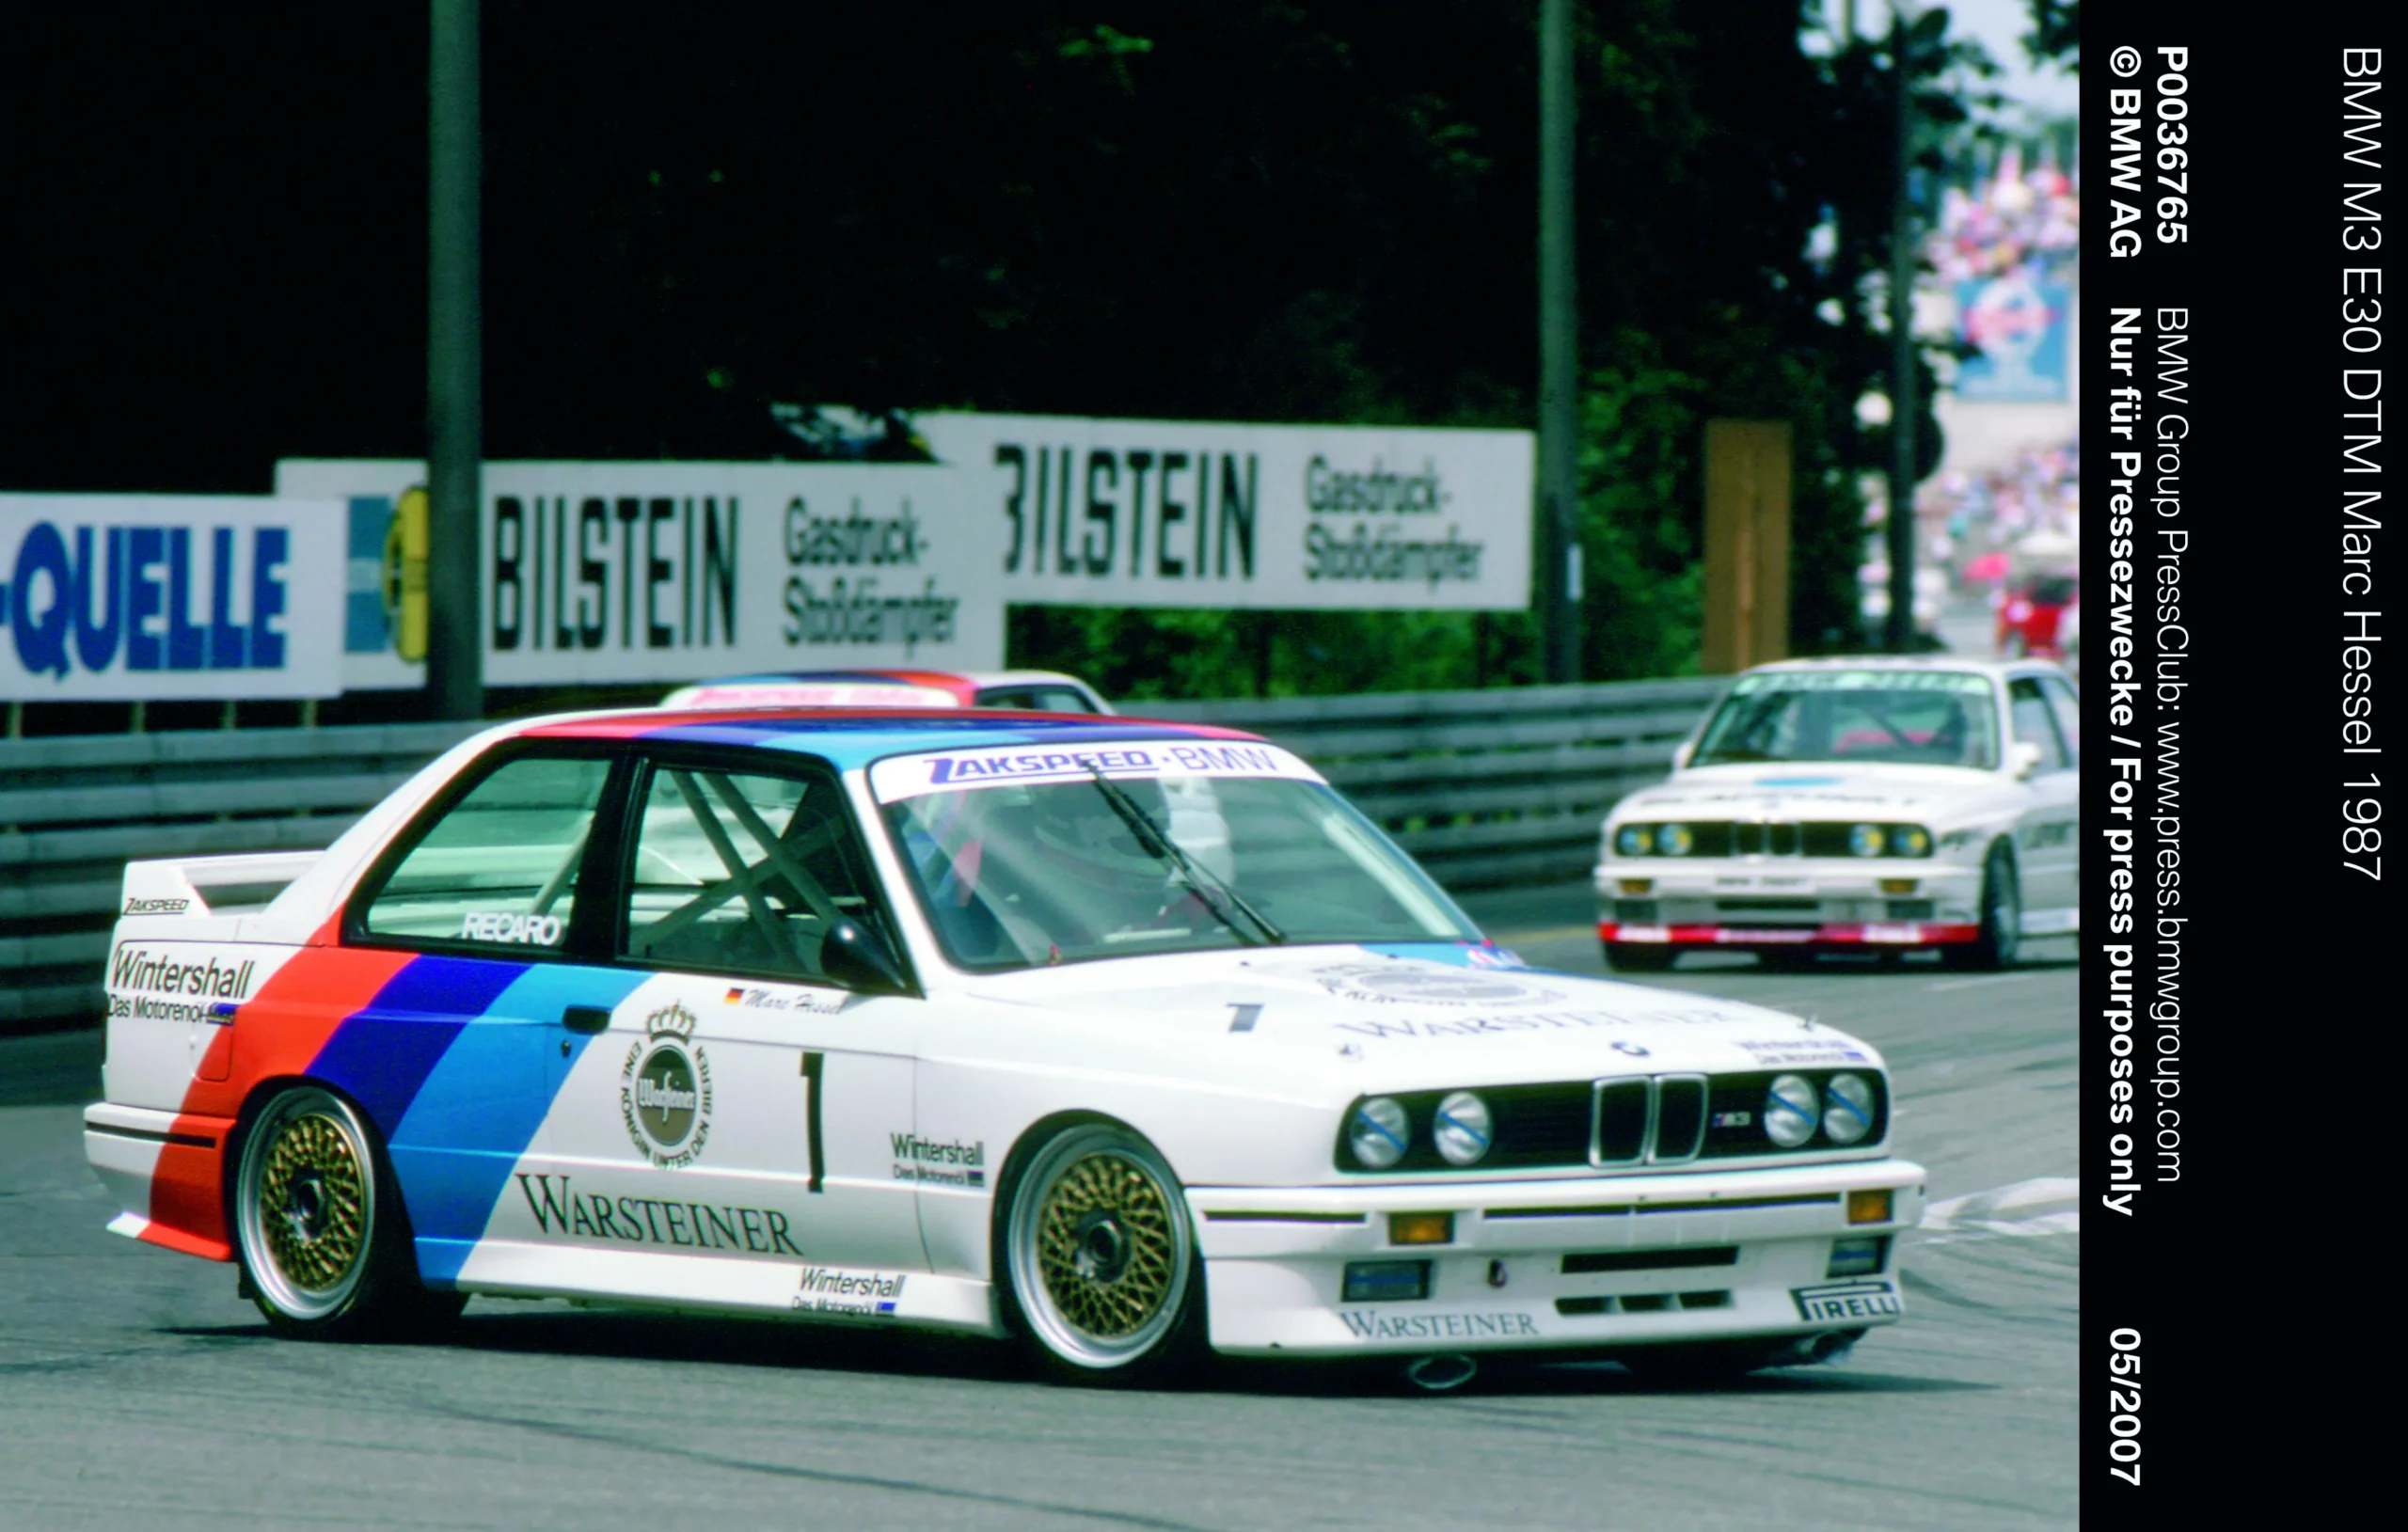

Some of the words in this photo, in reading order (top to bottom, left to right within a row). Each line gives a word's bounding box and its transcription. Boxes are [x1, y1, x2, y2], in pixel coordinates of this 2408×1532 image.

[785, 495, 927, 566] Gasdruck-
[493, 495, 737, 649] BILSTEIN
[784, 575, 958, 661] Stoßdämpfer
[923, 750, 1160, 785] ZAKSPEED
[1169, 746, 1278, 772] BMW
[123, 897, 189, 915] ZAKSPEED
[462, 911, 562, 946] RECARO
[113, 950, 256, 999] Wintershall
[108, 993, 131, 1019] Das
[1225, 1003, 1264, 1033] 1
[800, 1051, 824, 1193] 1
[890, 1132, 984, 1166] Wintershall
[515, 1173, 804, 1256] WARSTEINER
[800, 1267, 906, 1297] Wintershall
